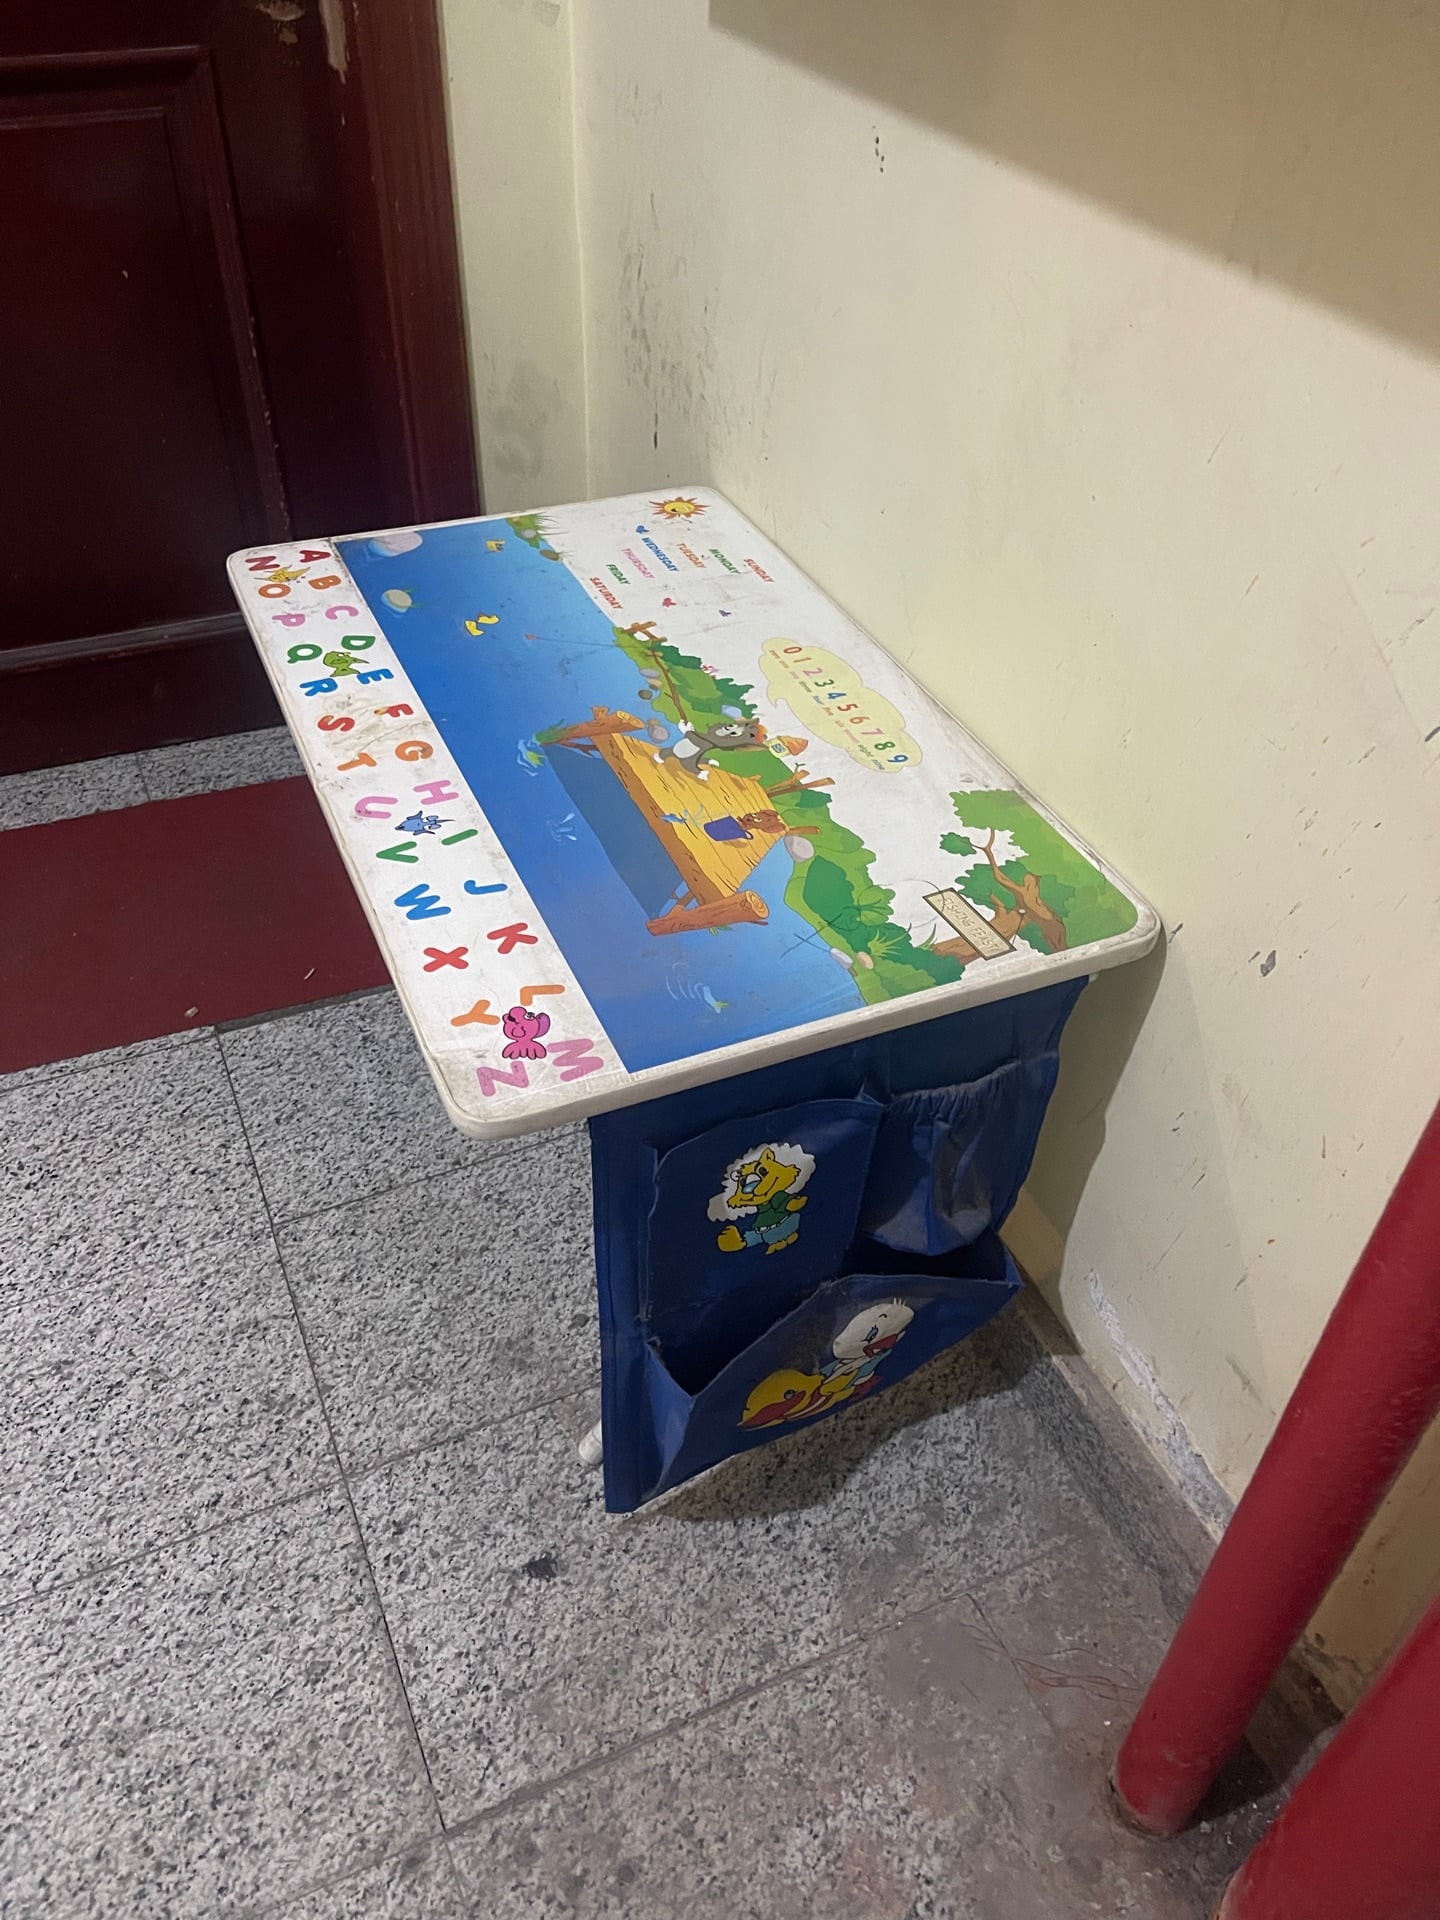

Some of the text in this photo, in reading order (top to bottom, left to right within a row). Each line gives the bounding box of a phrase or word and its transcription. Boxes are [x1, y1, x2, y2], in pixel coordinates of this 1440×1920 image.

[620, 548, 656, 579] THURSDAY
[642, 537, 680, 572] WEDNESDAY
[676, 543, 706, 569] TUESDAY
[708, 549, 741, 574] MONDAY
[744, 558, 776, 583] SUNDAY
[605, 564, 631, 585] FRIDAY
[589, 577, 623, 610] SATURDAY
[783, 646, 909, 764] 0 1 2 3 4 5 6 7 8 9
[245, 555, 529, 1096] N O P Q R S T U V W X Y Z
[300, 550, 604, 1082] A B C D E F G H I J K L M
